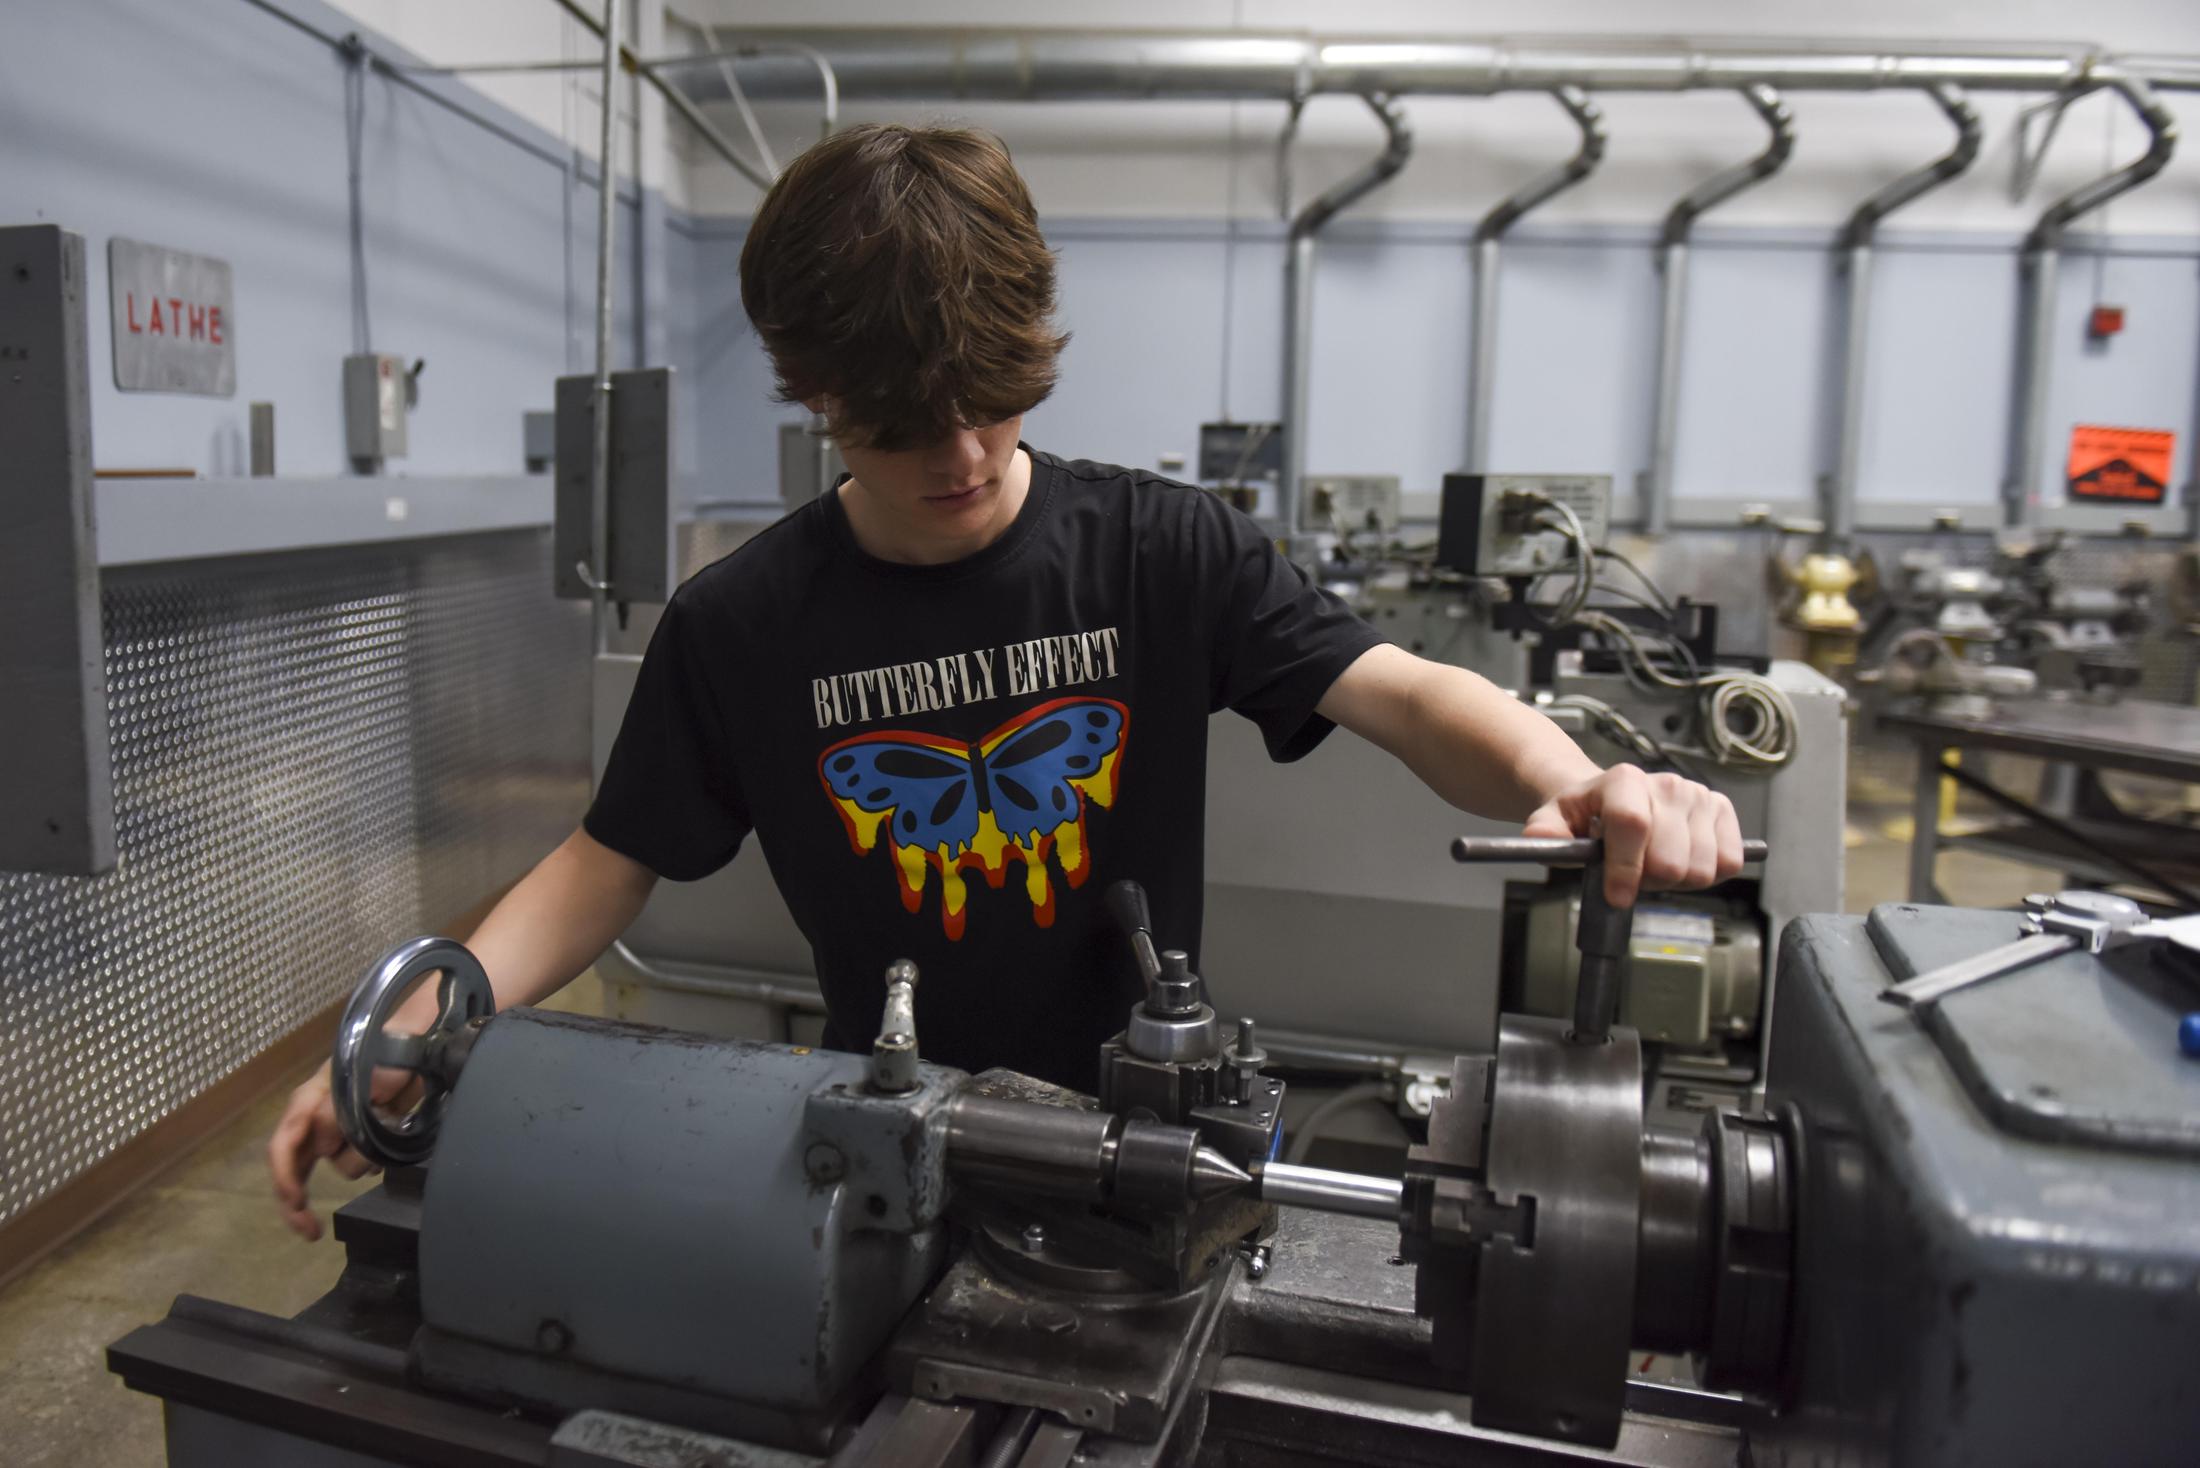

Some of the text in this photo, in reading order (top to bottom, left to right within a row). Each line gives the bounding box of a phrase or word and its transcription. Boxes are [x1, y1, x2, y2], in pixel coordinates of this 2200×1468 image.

[127, 292, 223, 344] LATHE
[812, 627, 1119, 729] BUTTERFLY EFFECT
